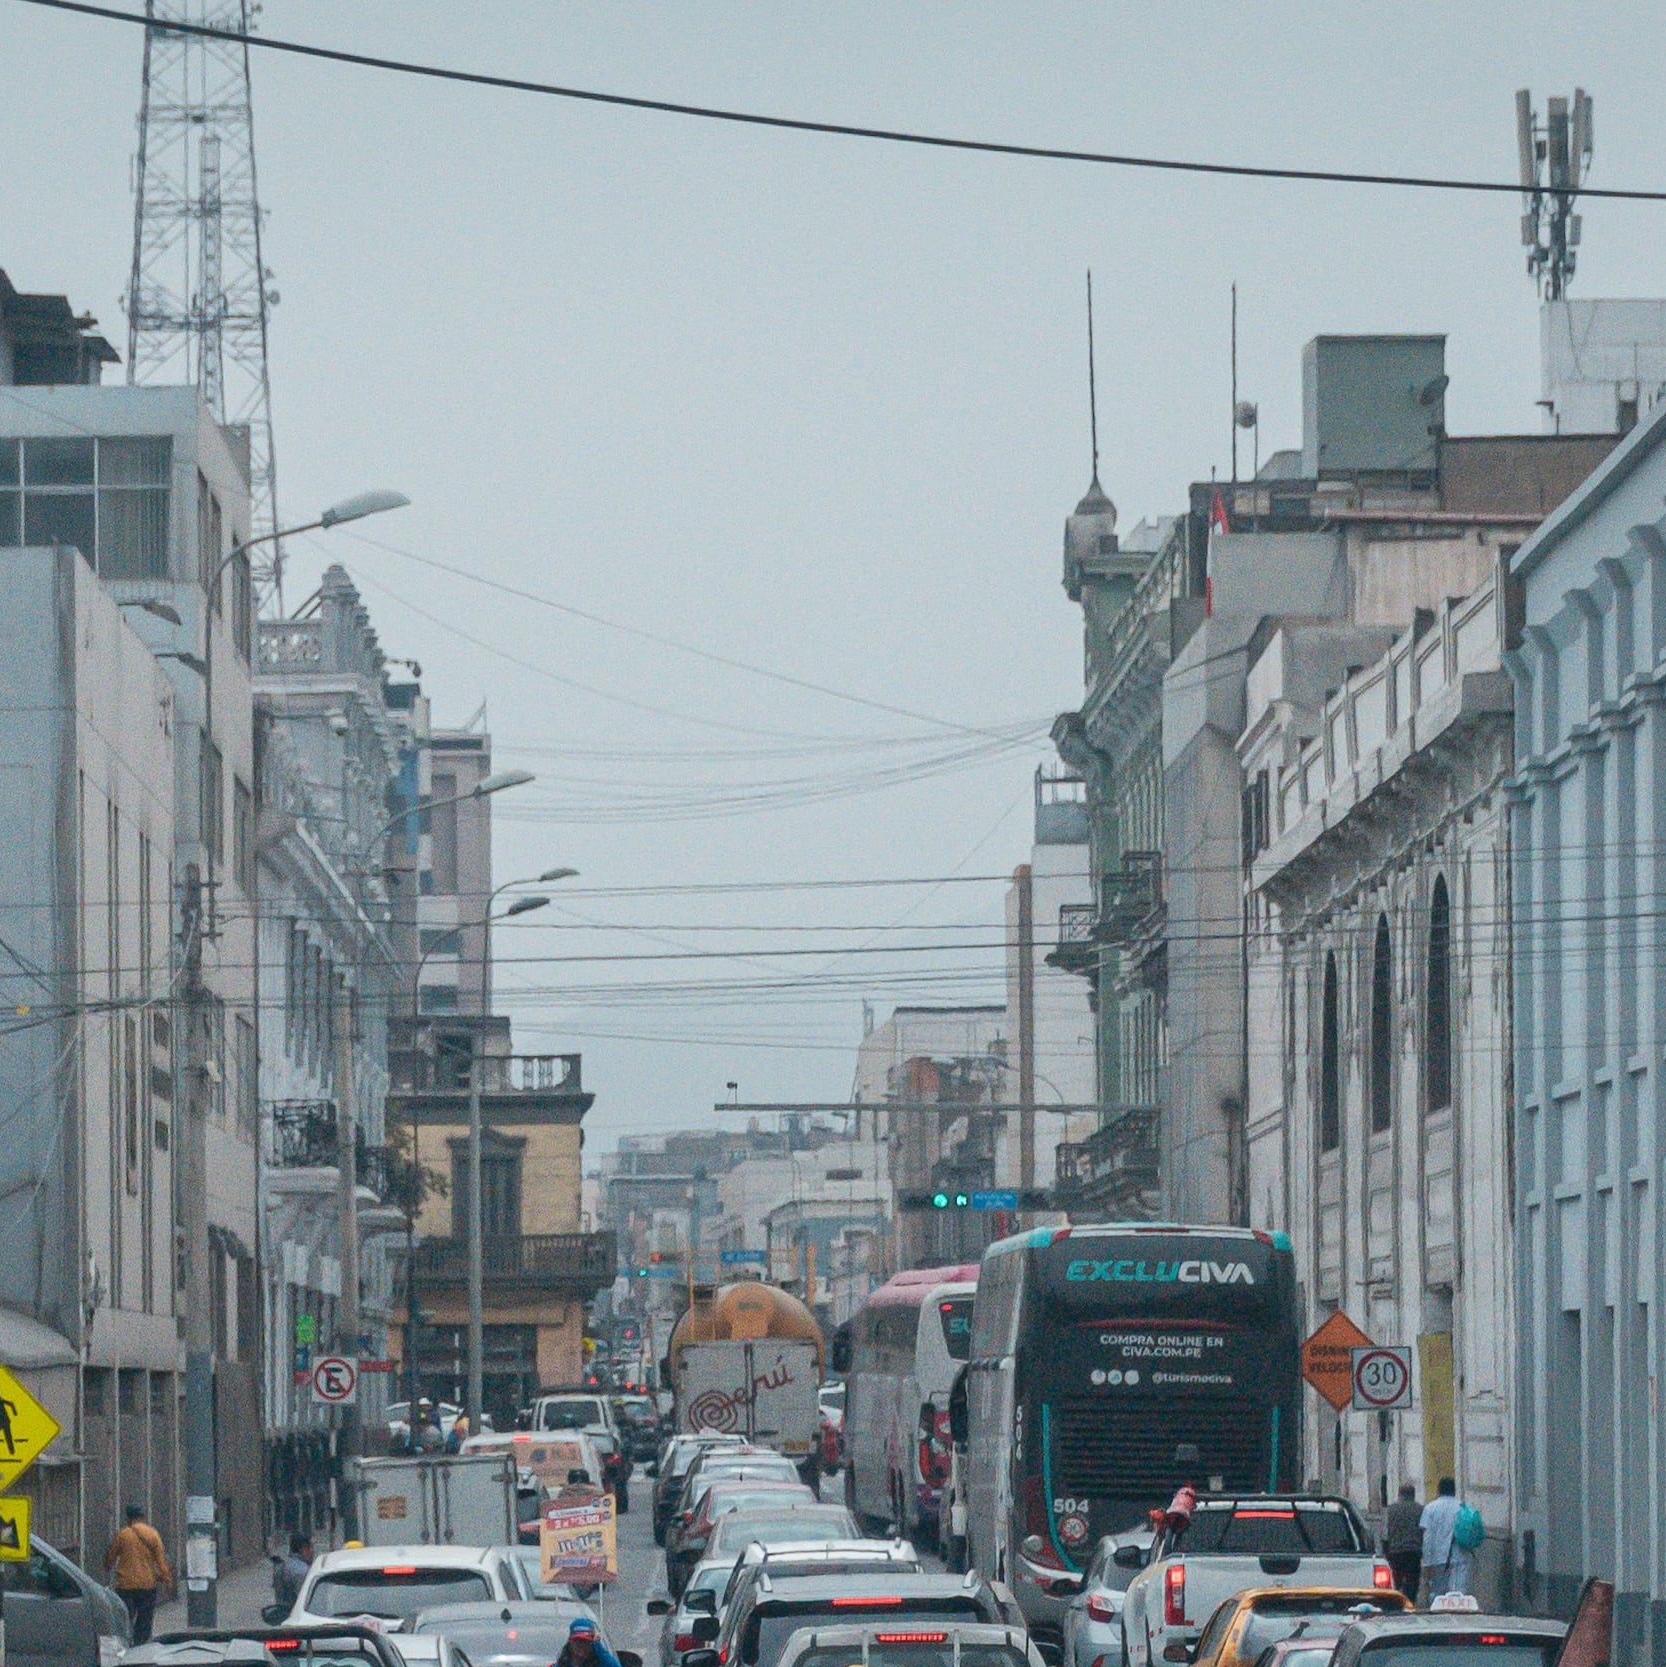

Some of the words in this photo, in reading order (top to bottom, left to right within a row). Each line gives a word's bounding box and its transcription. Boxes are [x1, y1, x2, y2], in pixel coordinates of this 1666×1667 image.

[1066, 1260, 1254, 1284] EXCLUCIVA
[1100, 1334, 1154, 1346] COMPRA
[1158, 1336, 1203, 1347] ONLINE
[1206, 1336, 1224, 1347] EN
[1122, 1346, 1201, 1358] CIVA.COM.PE
[1152, 1371, 1232, 1385] @turismociva
[1367, 1362, 1397, 1386] 30
[1053, 1498, 1089, 1514] 504
